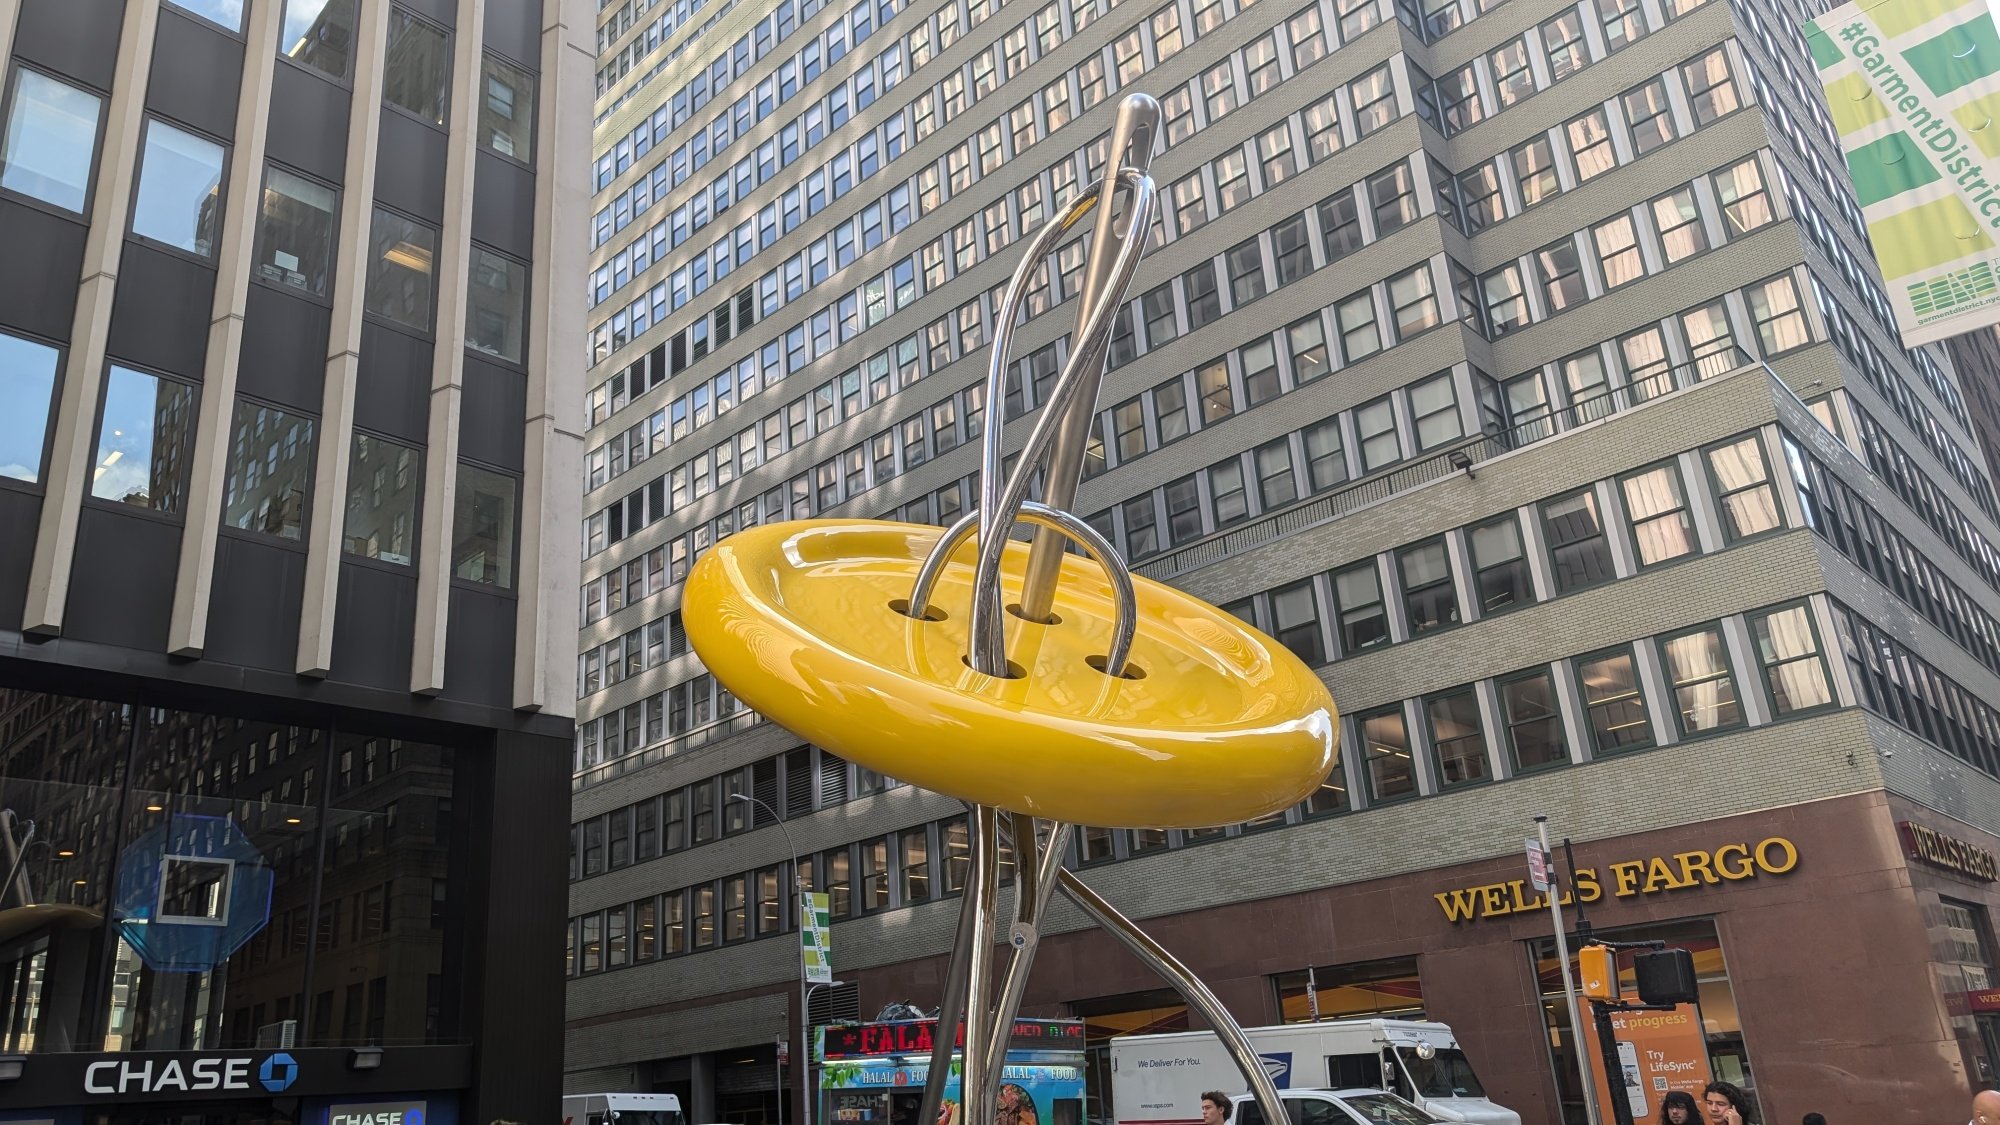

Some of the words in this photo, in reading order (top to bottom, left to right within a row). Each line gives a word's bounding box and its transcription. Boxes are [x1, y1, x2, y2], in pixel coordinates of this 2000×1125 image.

[1917, 295, 2000, 325] garmentdistrict.nyc
[1908, 821, 1962, 870] WELLS
[1956, 839, 1999, 882] FARGO
[1609, 837, 1798, 897] FARGO
[1629, 1013, 1688, 1030] progress
[1138, 1060, 1148, 1068] We
[1150, 1059, 1173, 1068] Deliver
[1174, 1058, 1186, 1066] For
[1646, 1050, 1664, 1061] Try
[84, 1058, 252, 1094] CHASE
[863, 1071, 892, 1084] HALAL
[911, 1070, 929, 1083] FOO
[1051, 1069, 1077, 1080] FOOD
[332, 1112, 402, 1125] CHASE
